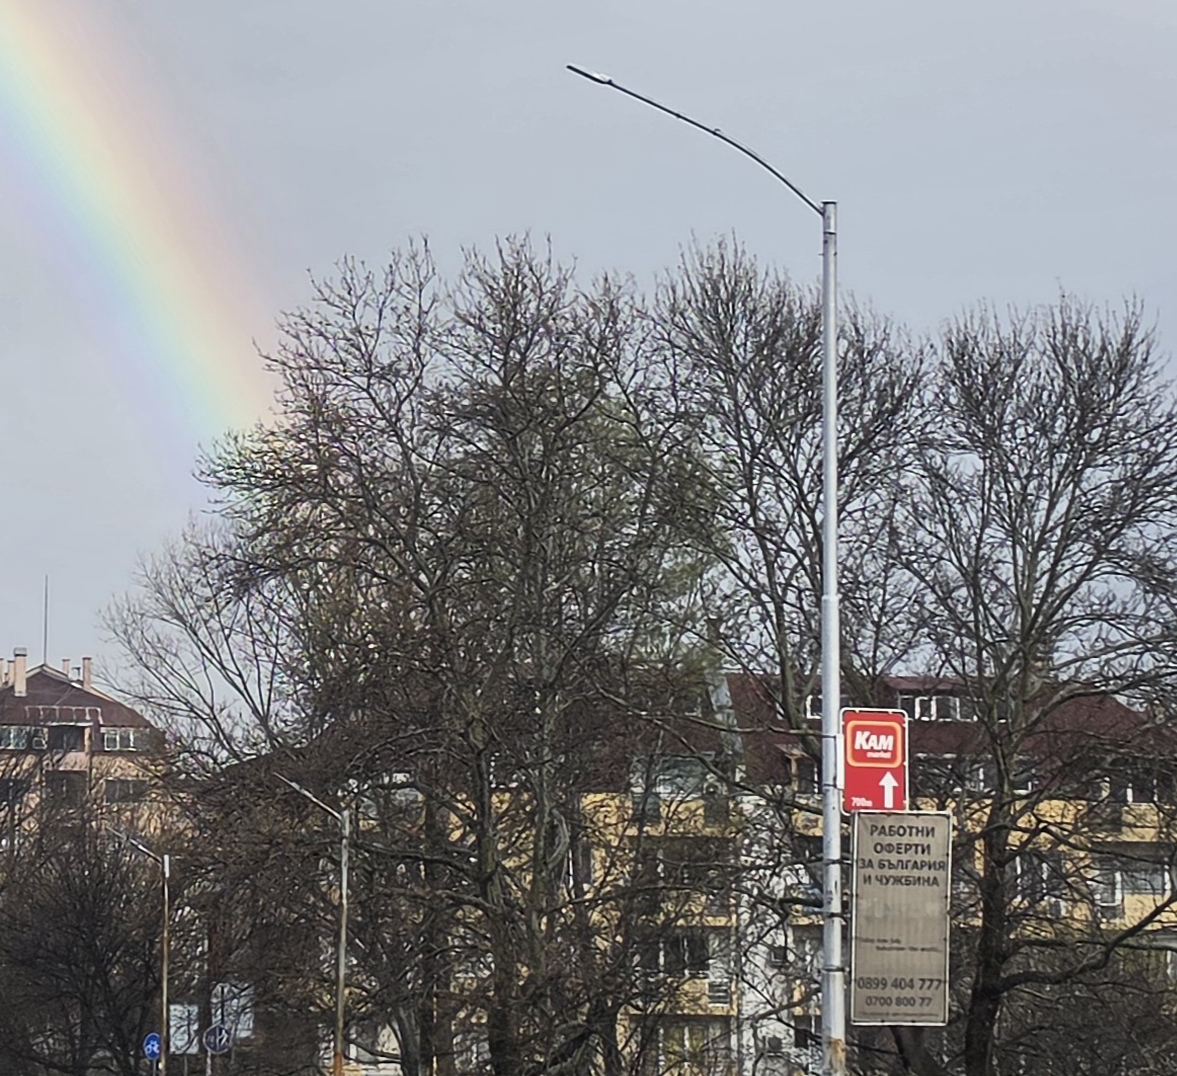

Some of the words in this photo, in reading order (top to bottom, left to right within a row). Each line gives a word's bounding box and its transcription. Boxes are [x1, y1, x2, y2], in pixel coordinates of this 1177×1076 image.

[854, 730, 894, 751] KAM
[870, 825, 935, 838] РАБОТНИ
[873, 842, 931, 855] ОФЕРТИ
[859, 858, 874, 870] ЗА
[878, 859, 946, 871] БЪЛГАРИЯ
[864, 874, 872, 885] И
[875, 875, 940, 887] ЧУЖБИНА
[857, 977, 888, 990] 0899
[891, 977, 915, 990] 404
[918, 978, 942, 990] 777
[865, 996, 893, 1007] 0700
[895, 996, 916, 1007] 800
[919, 997, 933, 1007] 77
